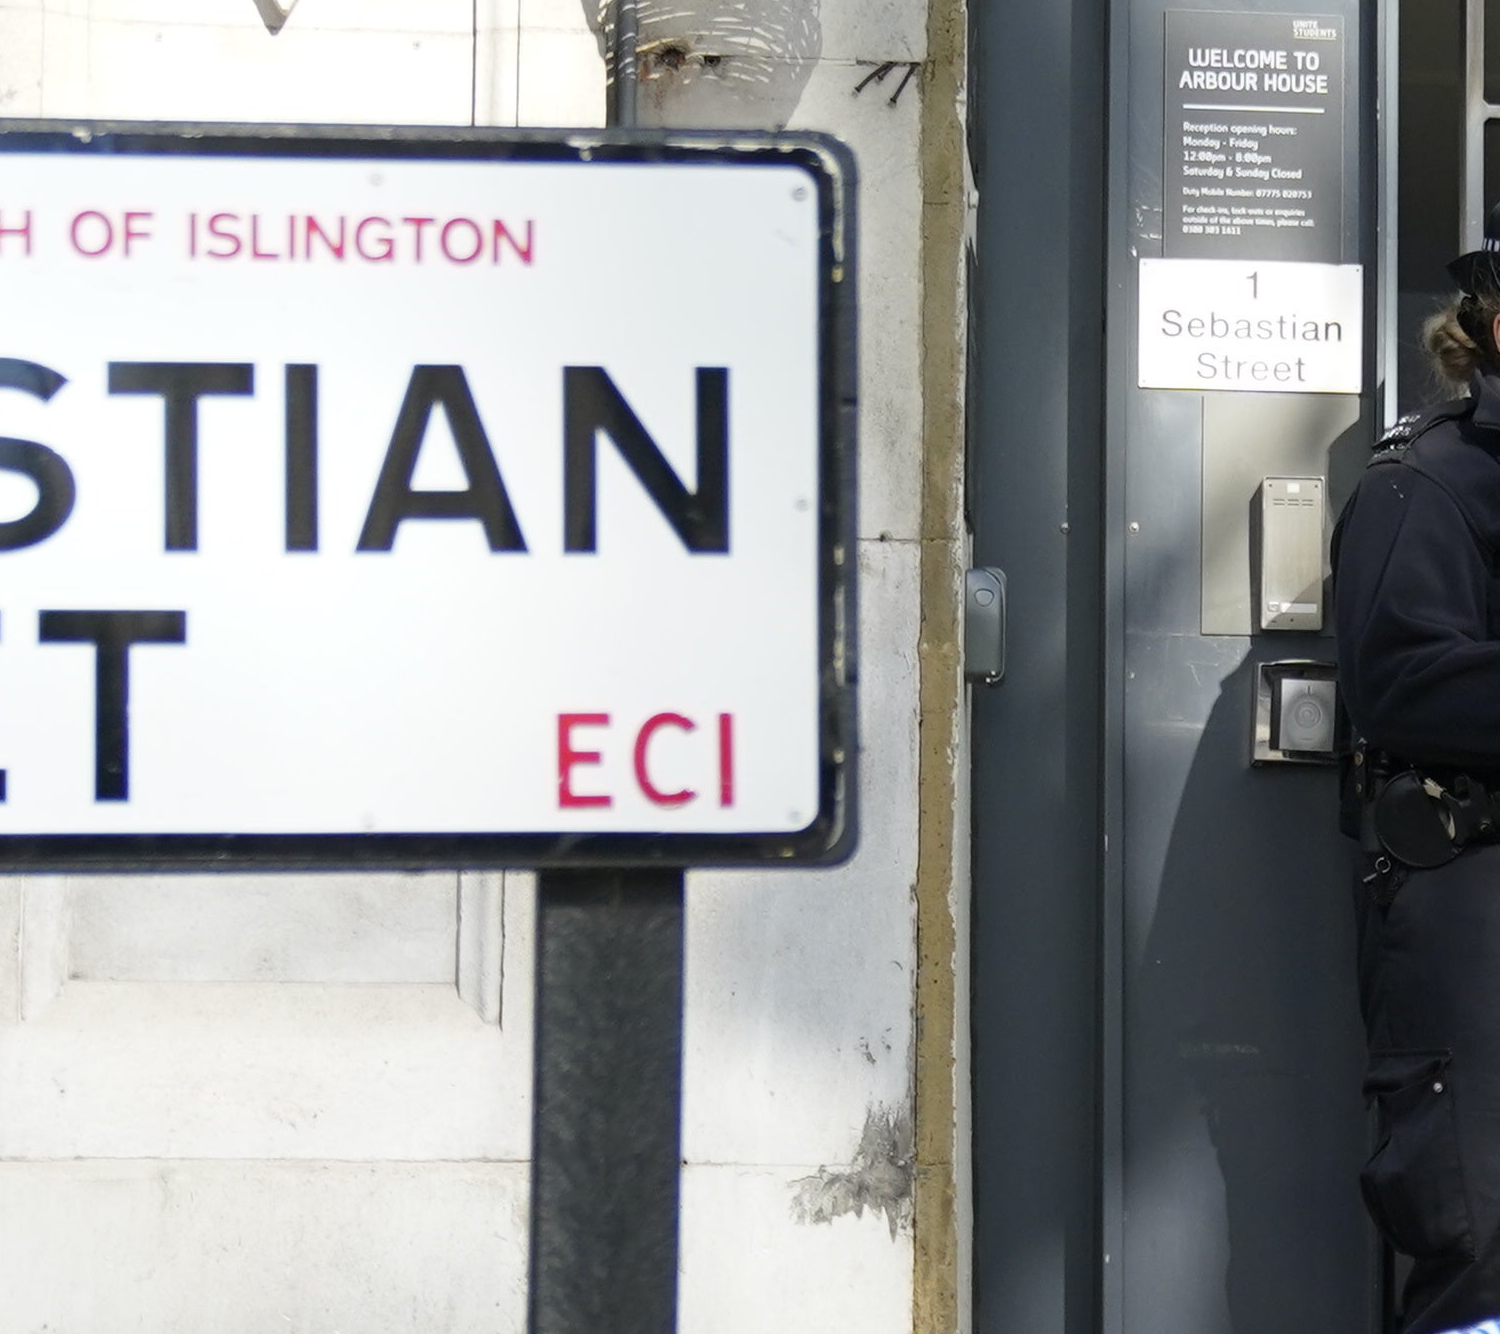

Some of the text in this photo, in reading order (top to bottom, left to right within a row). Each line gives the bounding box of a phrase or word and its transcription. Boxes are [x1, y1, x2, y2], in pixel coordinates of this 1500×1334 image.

[1292, 20, 1318, 29] UNITE
[1293, 28, 1337, 38] STUDENTS
[1188, 48, 1320, 70] WELCOME TO
[1179, 71, 1329, 94] ARBOUR HOUSE
[1183, 121, 1228, 134] Reception
[1230, 124, 1268, 136] opening
[1183, 136, 1221, 150] Monday
[1229, 138, 1259, 151] Friday
[1183, 166, 1303, 180] Saturday & Sunday Closed
[69, 210, 154, 260] OF
[184, 214, 538, 266] ISLINGTON
[1246, 271, 1258, 299] 1
[1161, 309, 1342, 342] Sebastian
[1197, 352, 1306, 382] Street
